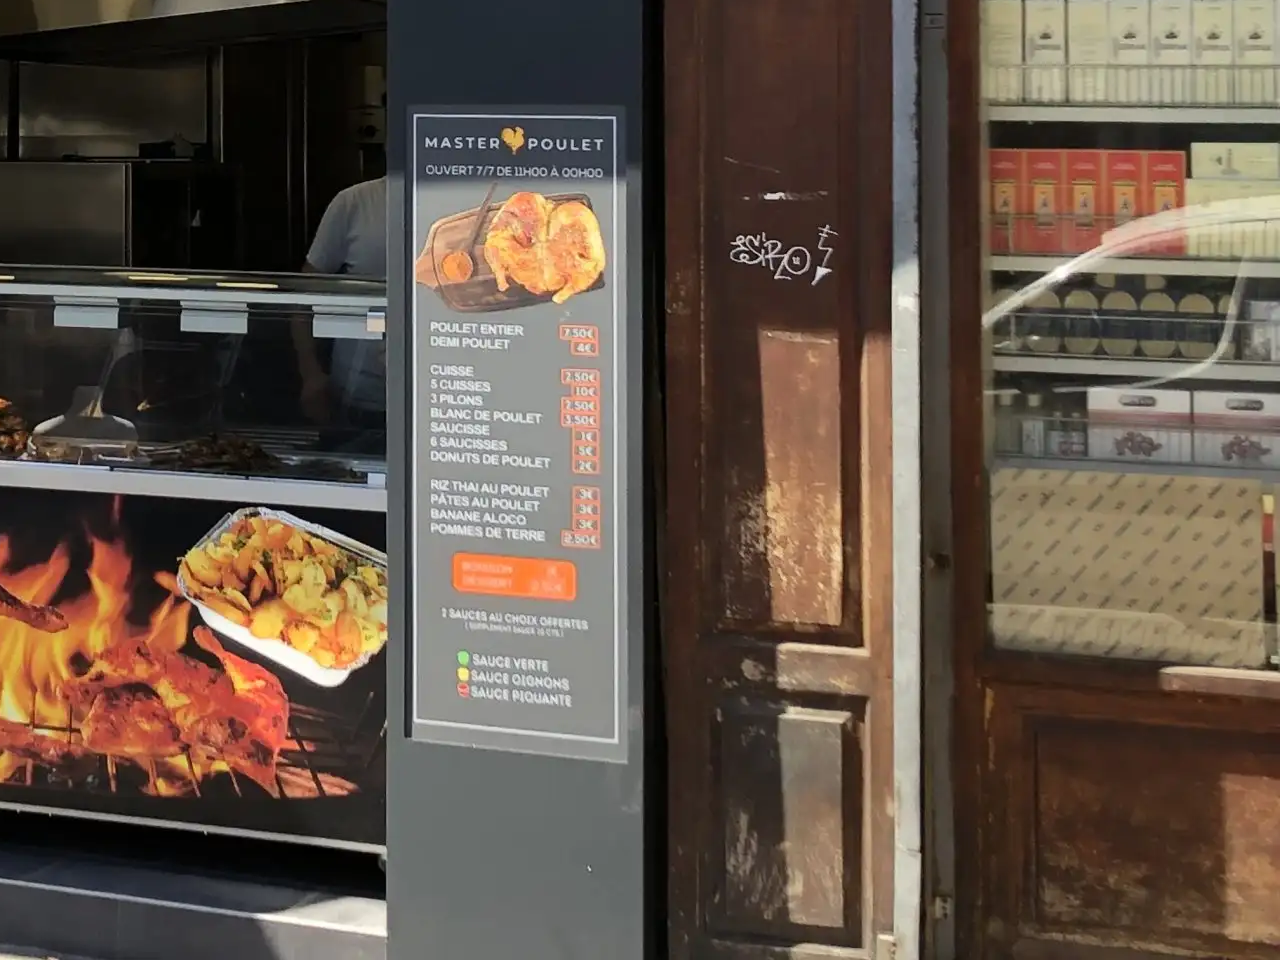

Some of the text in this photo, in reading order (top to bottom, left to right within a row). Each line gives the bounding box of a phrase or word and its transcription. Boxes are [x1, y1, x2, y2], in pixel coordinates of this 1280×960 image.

[424, 137, 605, 151] MASTER POULET
[425, 164, 604, 179] OUVERT 7/7 DE 11H00 À 00H00
[430, 321, 524, 337] POULET ENTIER
[430, 336, 511, 350] DEMI POULET
[430, 365, 474, 377] CUISSE
[430, 378, 491, 393] 5 CUISSES
[430, 392, 483, 406] 3 PILONS
[430, 407, 543, 425] BLANC DE POULET
[430, 422, 490, 436] SAUCISSE
[430, 436, 508, 452] 6 SAUCISSES
[430, 450, 551, 469] DONUTS DE POULET
[430, 478, 450, 491] RIZ
[481, 482, 499, 495] AU
[500, 484, 550, 499] POULET
[471, 496, 490, 509] AU
[491, 498, 540, 513] POULET
[430, 508, 480, 523] BANANE
[430, 522, 546, 542] POMMES DE TERRE
[449, 607, 488, 622] SAUCES
[489, 612, 503, 623] AU
[504, 613, 538, 626] CHOIX
[472, 653, 549, 674] SAUCE VERTE
[470, 669, 571, 692] SAUCE OIGNONS
[470, 685, 573, 708] SAUCE PIQUANTE
